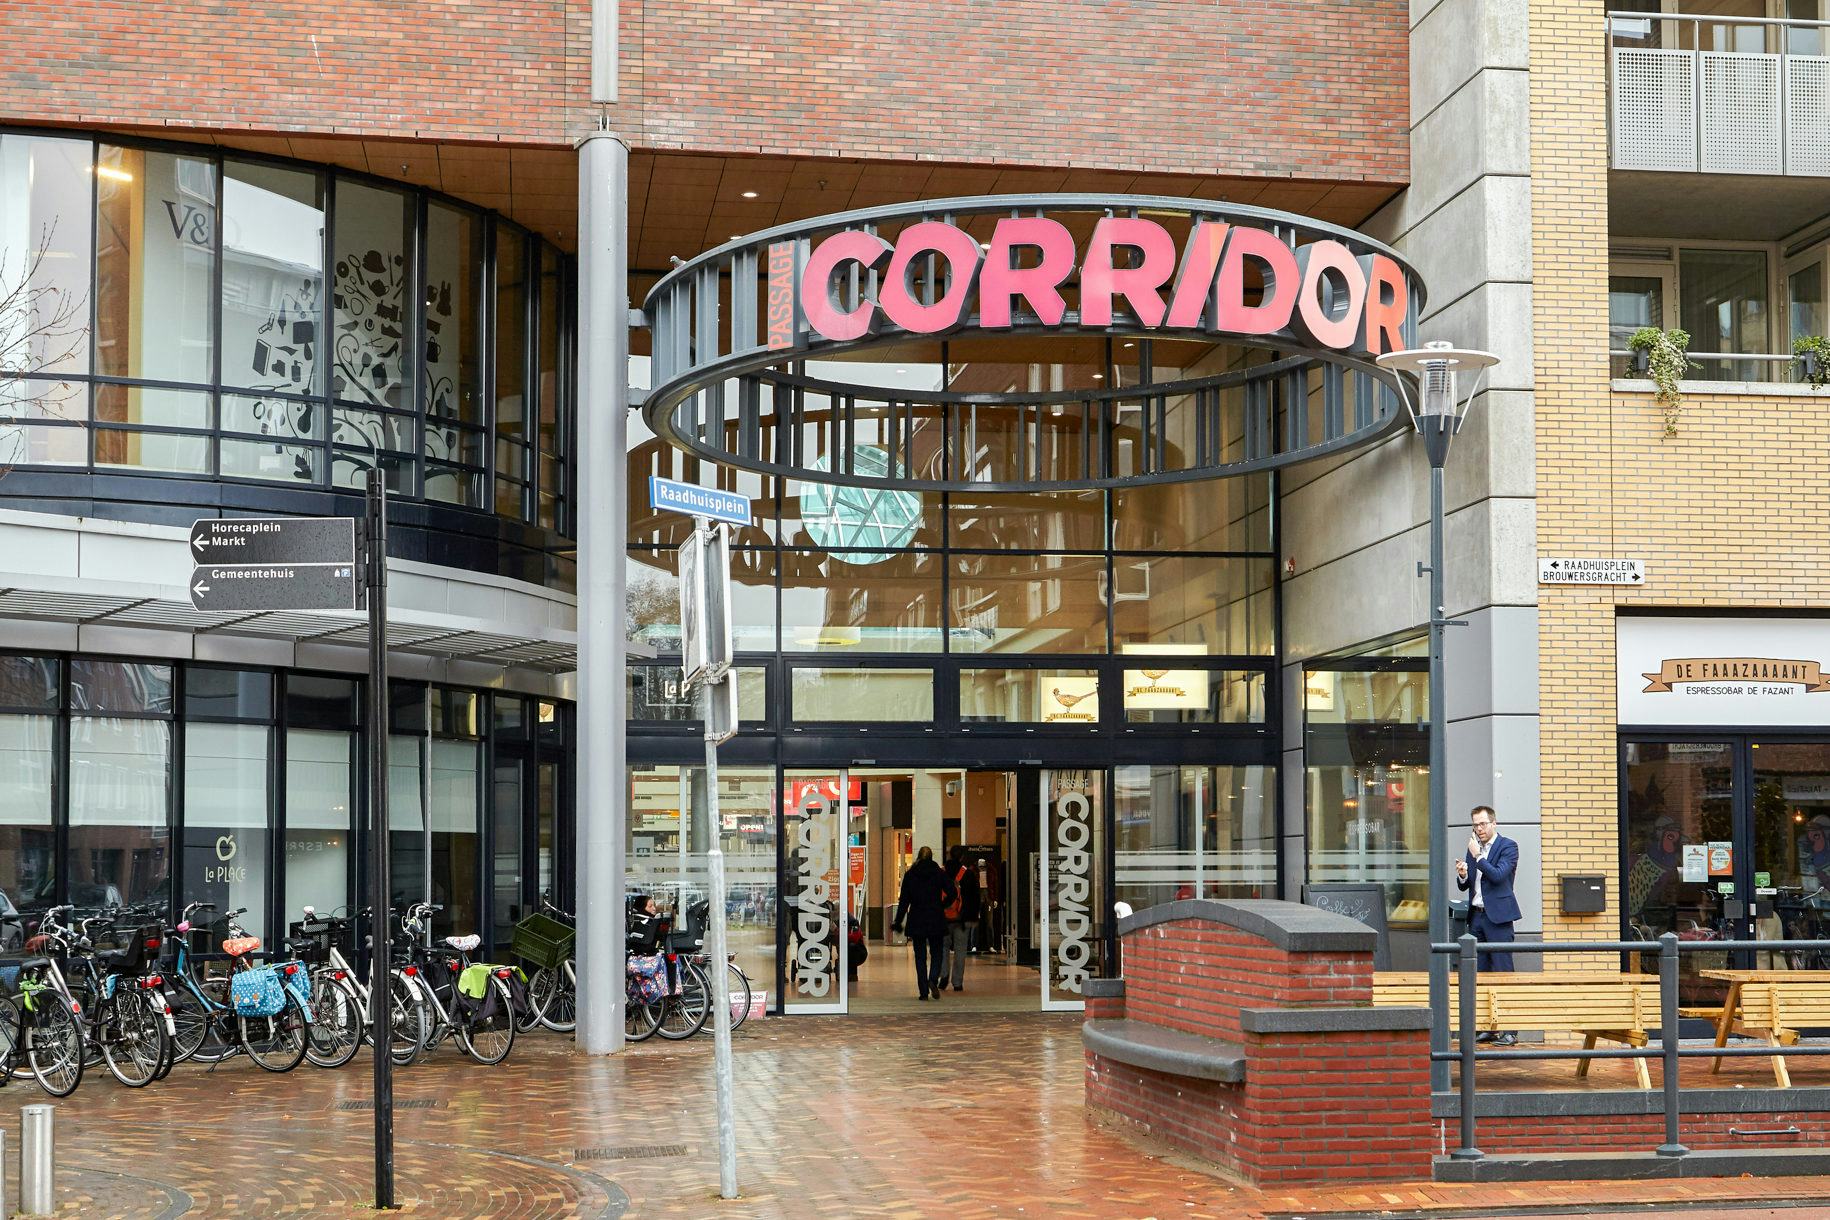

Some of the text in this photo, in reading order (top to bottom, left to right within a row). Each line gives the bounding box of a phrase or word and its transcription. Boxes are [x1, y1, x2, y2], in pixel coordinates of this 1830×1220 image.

[801, 216, 1408, 356] CORRIDOR
[768, 241, 796, 350] PASSAGE
[660, 484, 745, 515] Raadhuisplein
[211, 522, 281, 534] Horecaplein
[211, 536, 246, 546] Markt
[1564, 560, 1636, 571] RAADHUISPLEIN
[211, 568, 294, 579] Gemeentehuis
[1543, 571, 1627, 582] BROUWERSGRACHT
[1676, 663, 1807, 680] DE FAAAZAAAANT
[1686, 686, 1794, 696] ESPRESSOBAR DE FAZANT
[1057, 778, 1089, 789] PASSAGE
[205, 866, 246, 882] La PLACE
[797, 792, 831, 998] CORRIDOR
[1057, 791, 1090, 994] CORRIDOR
